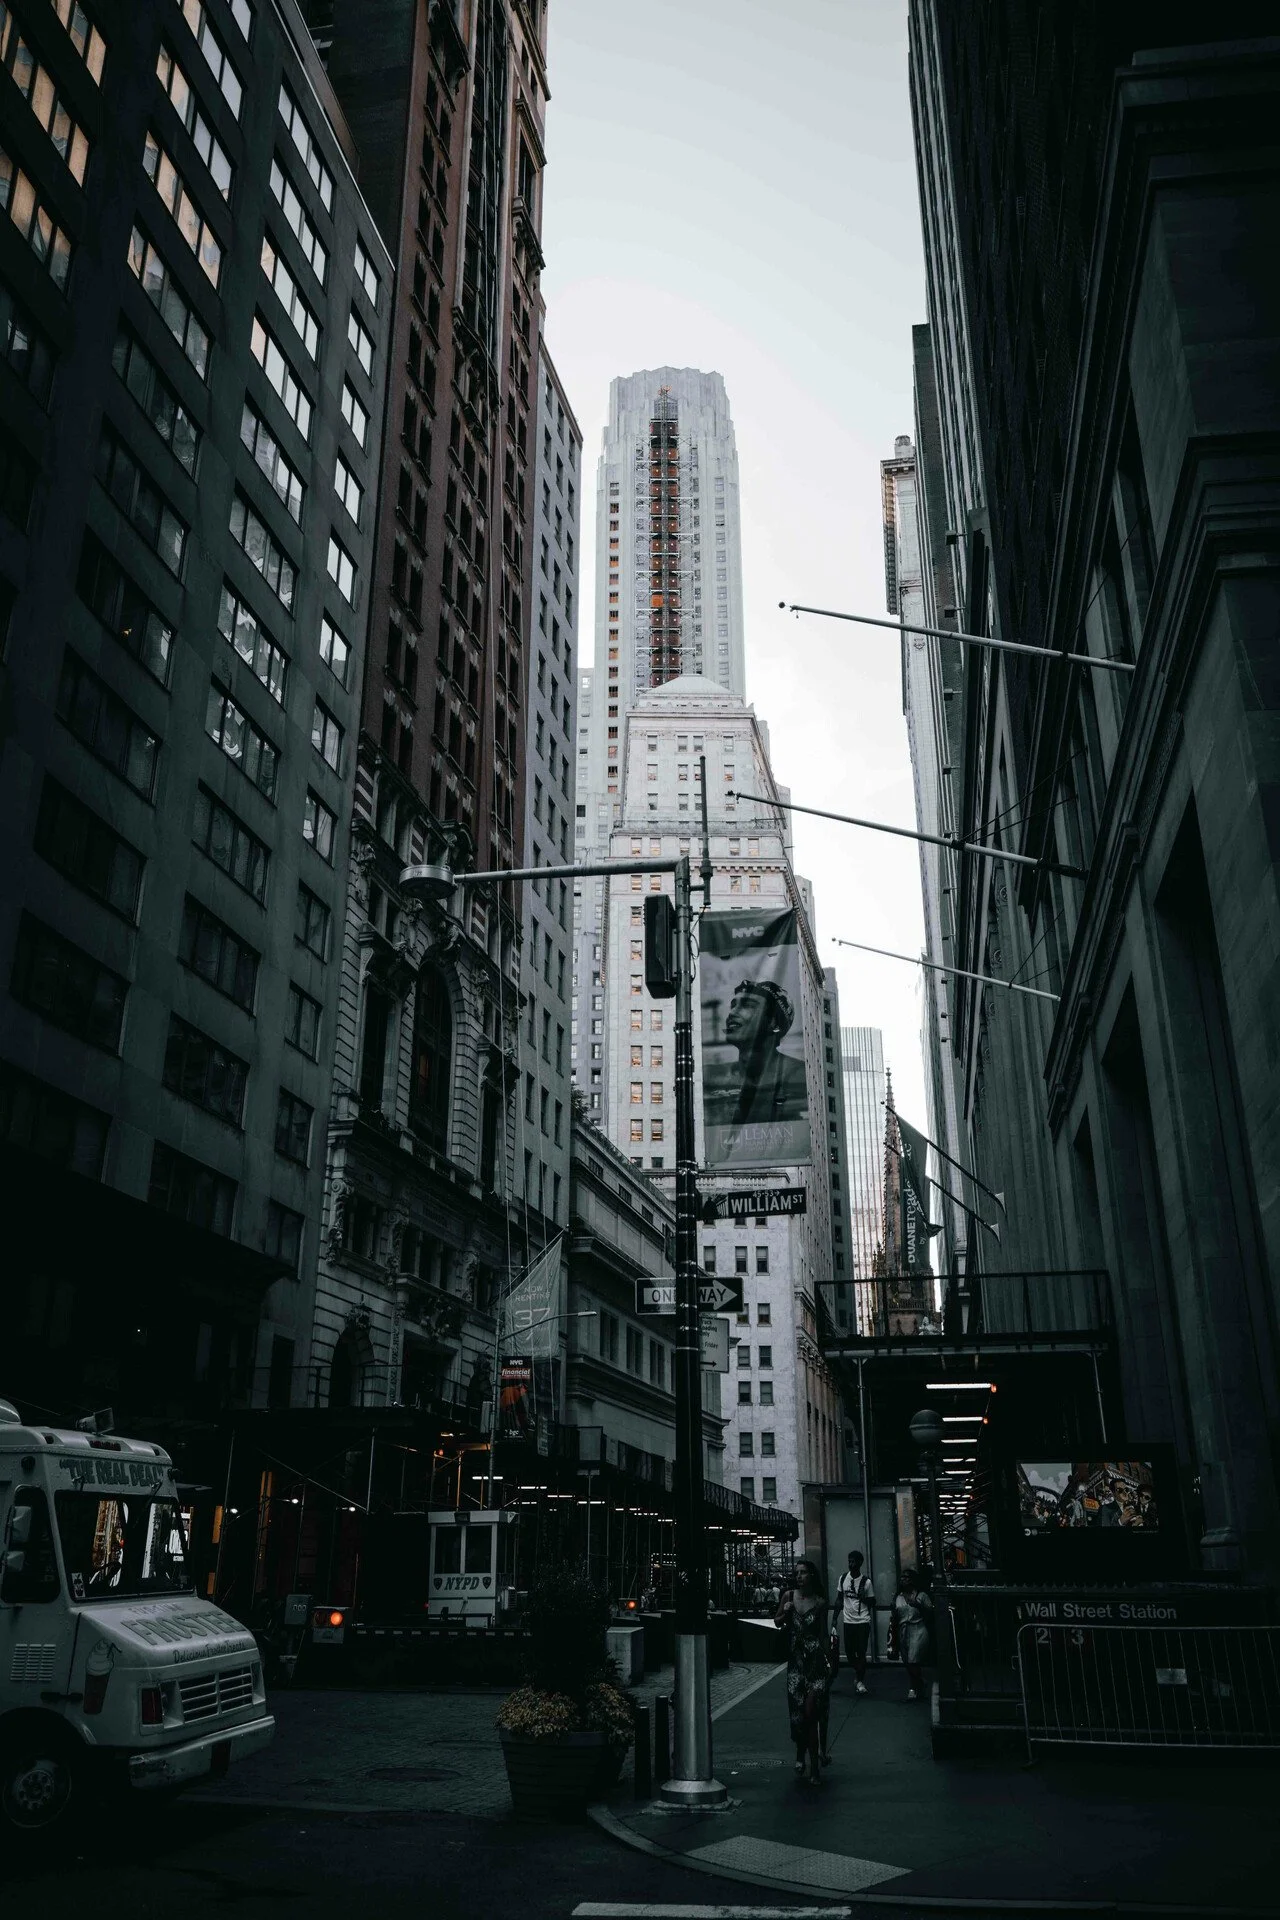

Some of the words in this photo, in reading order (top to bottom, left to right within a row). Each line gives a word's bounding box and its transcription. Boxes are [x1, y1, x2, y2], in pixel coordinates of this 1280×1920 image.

[732, 926, 765, 939] NYC
[731, 1195, 792, 1214] WILLIAM
[792, 1194, 804, 1204] ST
[515, 1291, 551, 1302] RENTING
[524, 1285, 543, 1294] NOW
[652, 1289, 676, 1303] ON
[515, 1307, 551, 1340] 37
[701, 1325, 718, 1333] oading
[501, 1368, 531, 1377] financial
[95, 1460, 130, 1486] REAL
[444, 1576, 480, 1591] NYPD
[1025, 1602, 1057, 1618] Wall
[1062, 1602, 1113, 1619] Street
[1119, 1603, 1177, 1620] Station
[119, 1610, 247, 1646] FROSTEE
[1036, 1627, 1050, 1645] 2
[1070, 1628, 1085, 1646] 3
